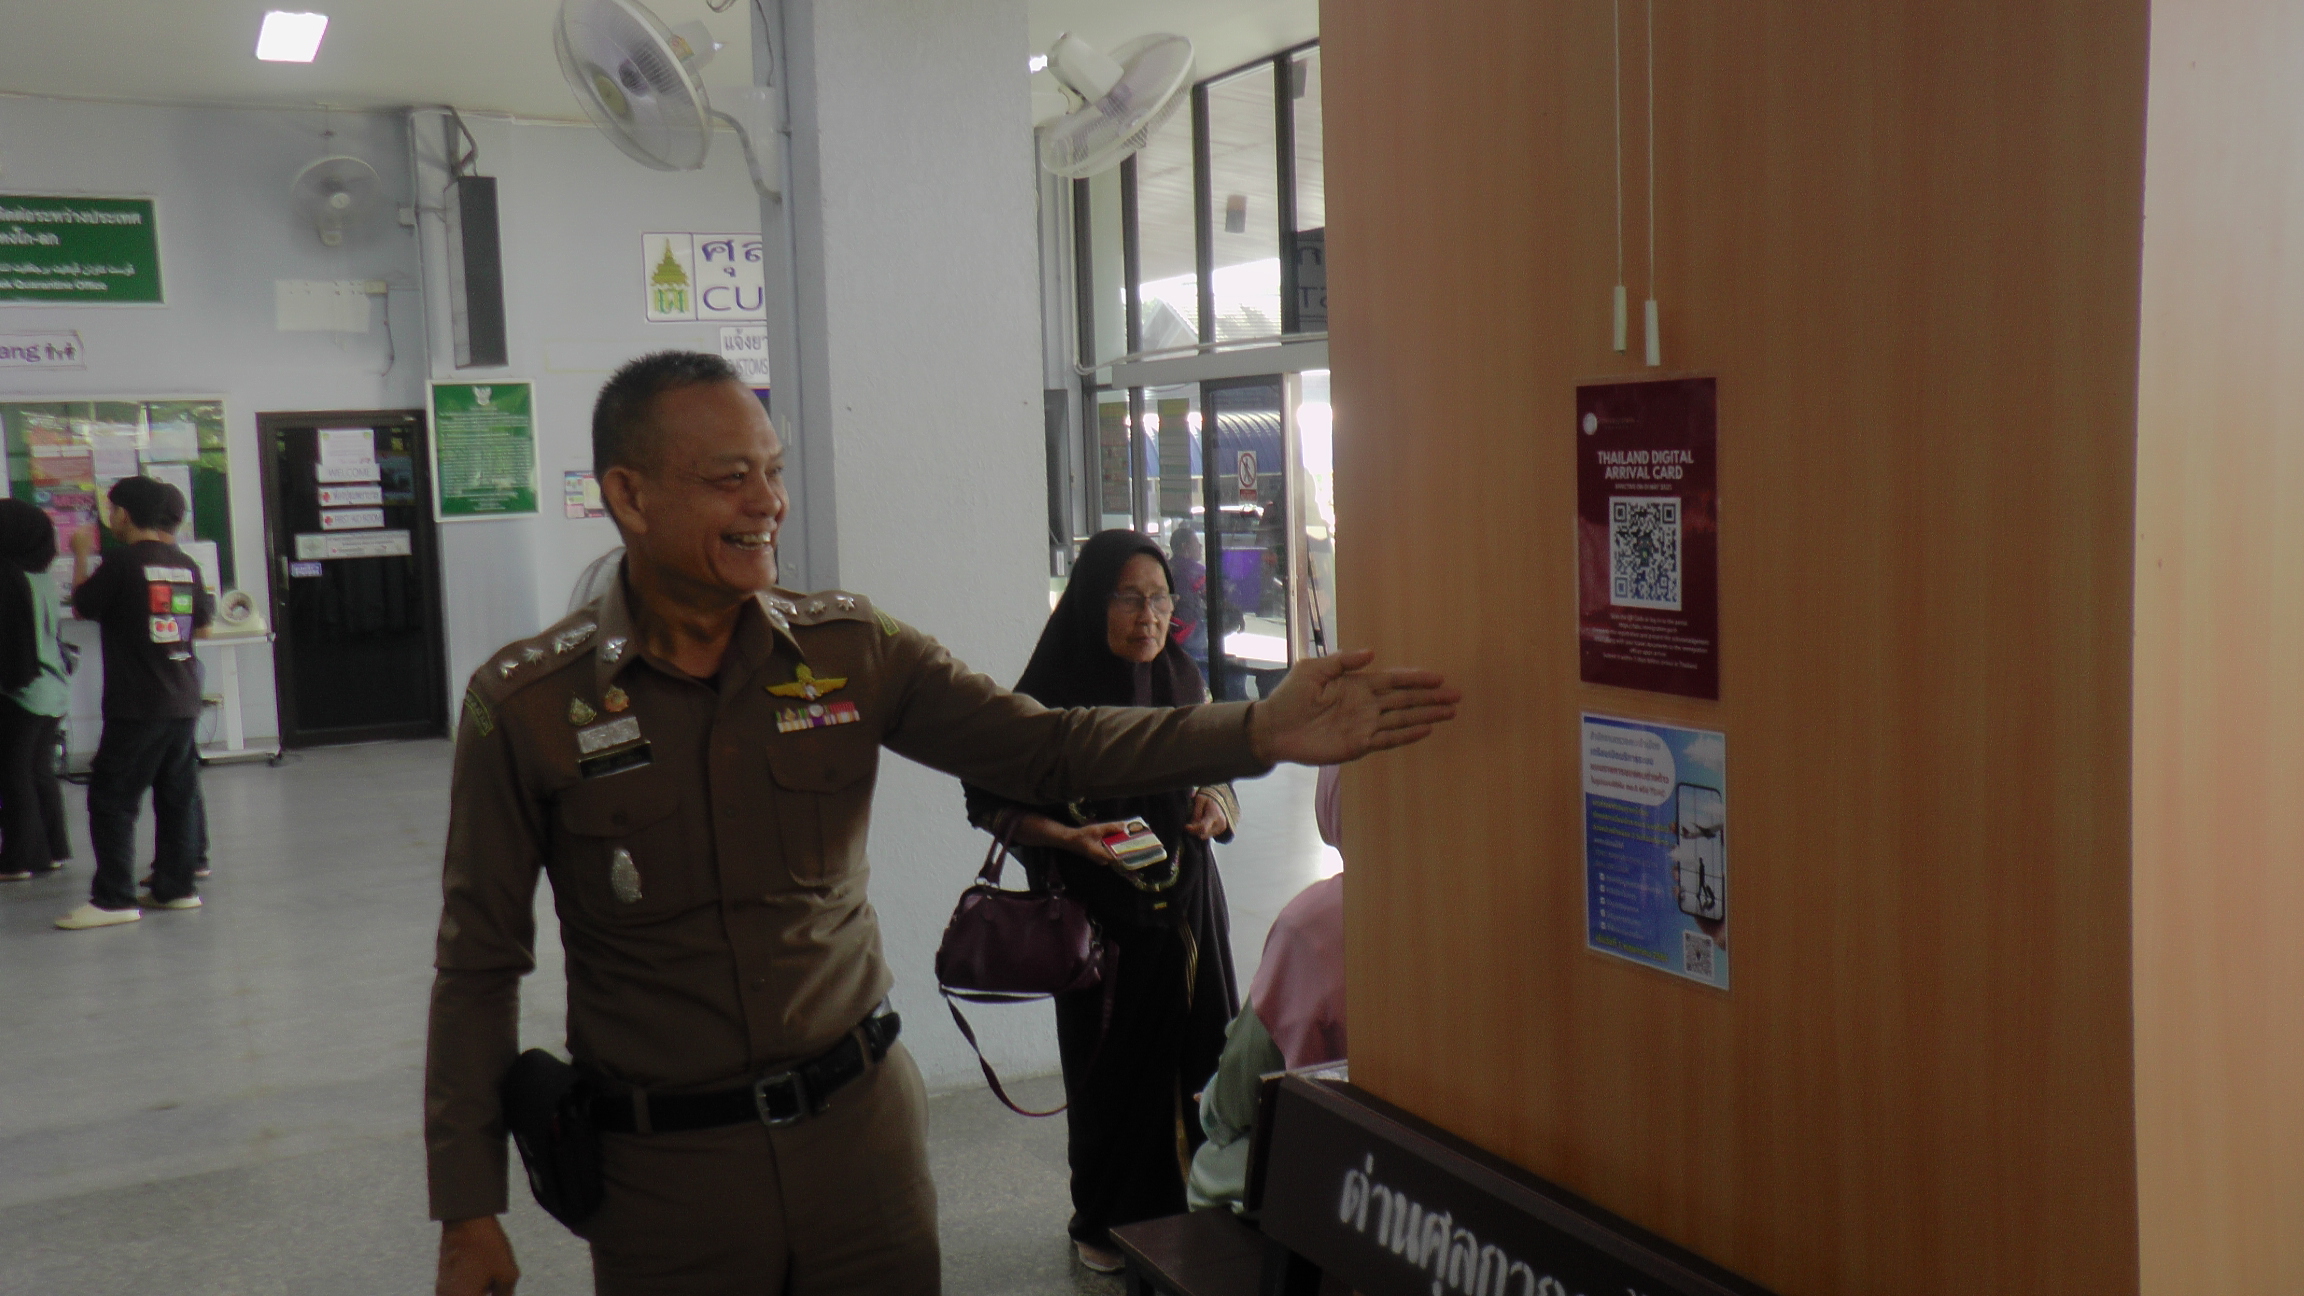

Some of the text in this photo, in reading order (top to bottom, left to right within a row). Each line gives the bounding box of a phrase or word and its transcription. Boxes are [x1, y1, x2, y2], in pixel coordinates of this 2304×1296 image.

[1598, 450, 1694, 465] THAILAND DIGITAL
[328, 468, 370, 478] WELCOME
[1605, 466, 1683, 480] ARRIVAL CARD
